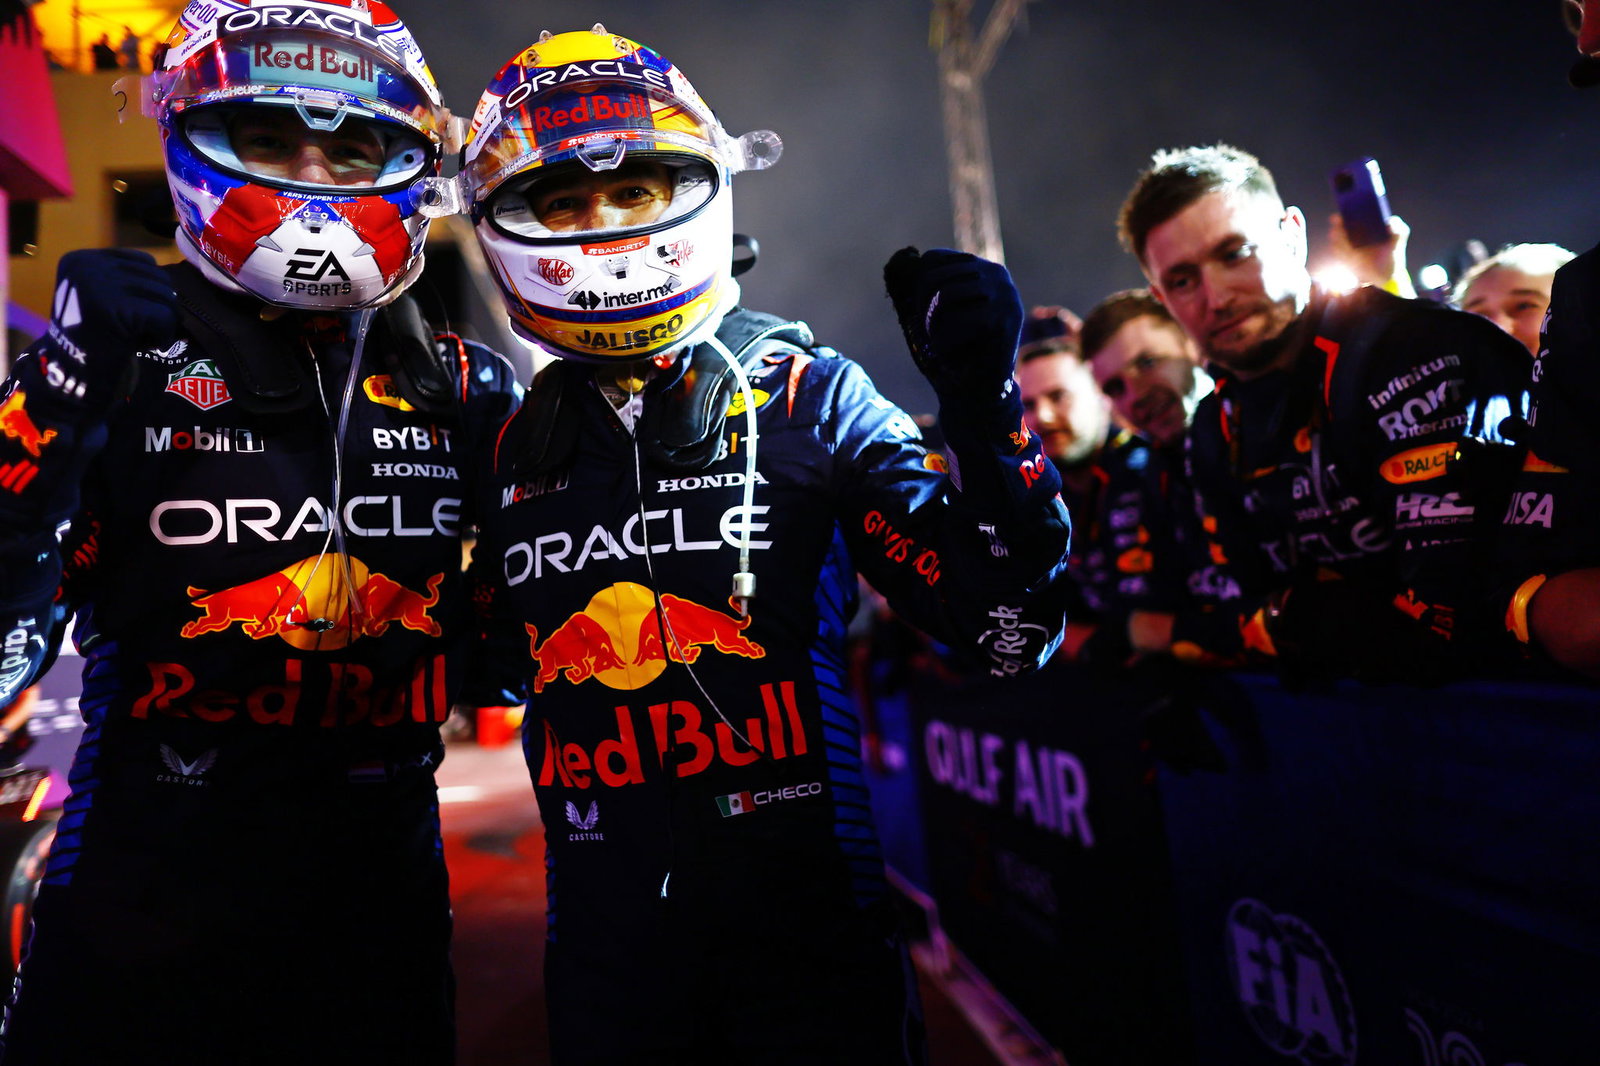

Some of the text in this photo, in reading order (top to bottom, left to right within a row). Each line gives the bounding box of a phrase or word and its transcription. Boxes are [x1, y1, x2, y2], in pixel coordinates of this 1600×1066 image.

[224, 7, 401, 60] ORACLE
[254, 41, 314, 72] Red
[320, 48, 374, 83] Bull
[505, 61, 668, 109] ORACLE
[534, 95, 648, 132] Red Bull
[285, 248, 350, 281] EA
[598, 239, 646, 255] BANORTE
[283, 278, 352, 297] SPORTS
[541, 260, 573, 285] KitKat
[603, 280, 673, 308] inter.mx
[576, 313, 684, 350] JALISCO
[1367, 353, 1462, 411] infinitum
[145, 425, 230, 453] Mobil
[372, 425, 452, 453] BYBIT
[371, 462, 461, 480] HONDA
[656, 471, 769, 494] HONDA
[150, 495, 463, 546] ORACLE
[504, 505, 773, 587] ORACLE
[129, 657, 304, 728] Red
[319, 653, 448, 728] Bull
[648, 680, 809, 778] Bull
[753, 782, 823, 806] CHECO
[925, 719, 1096, 849] GULF AIR
[568, 832, 604, 841] CASTORE
